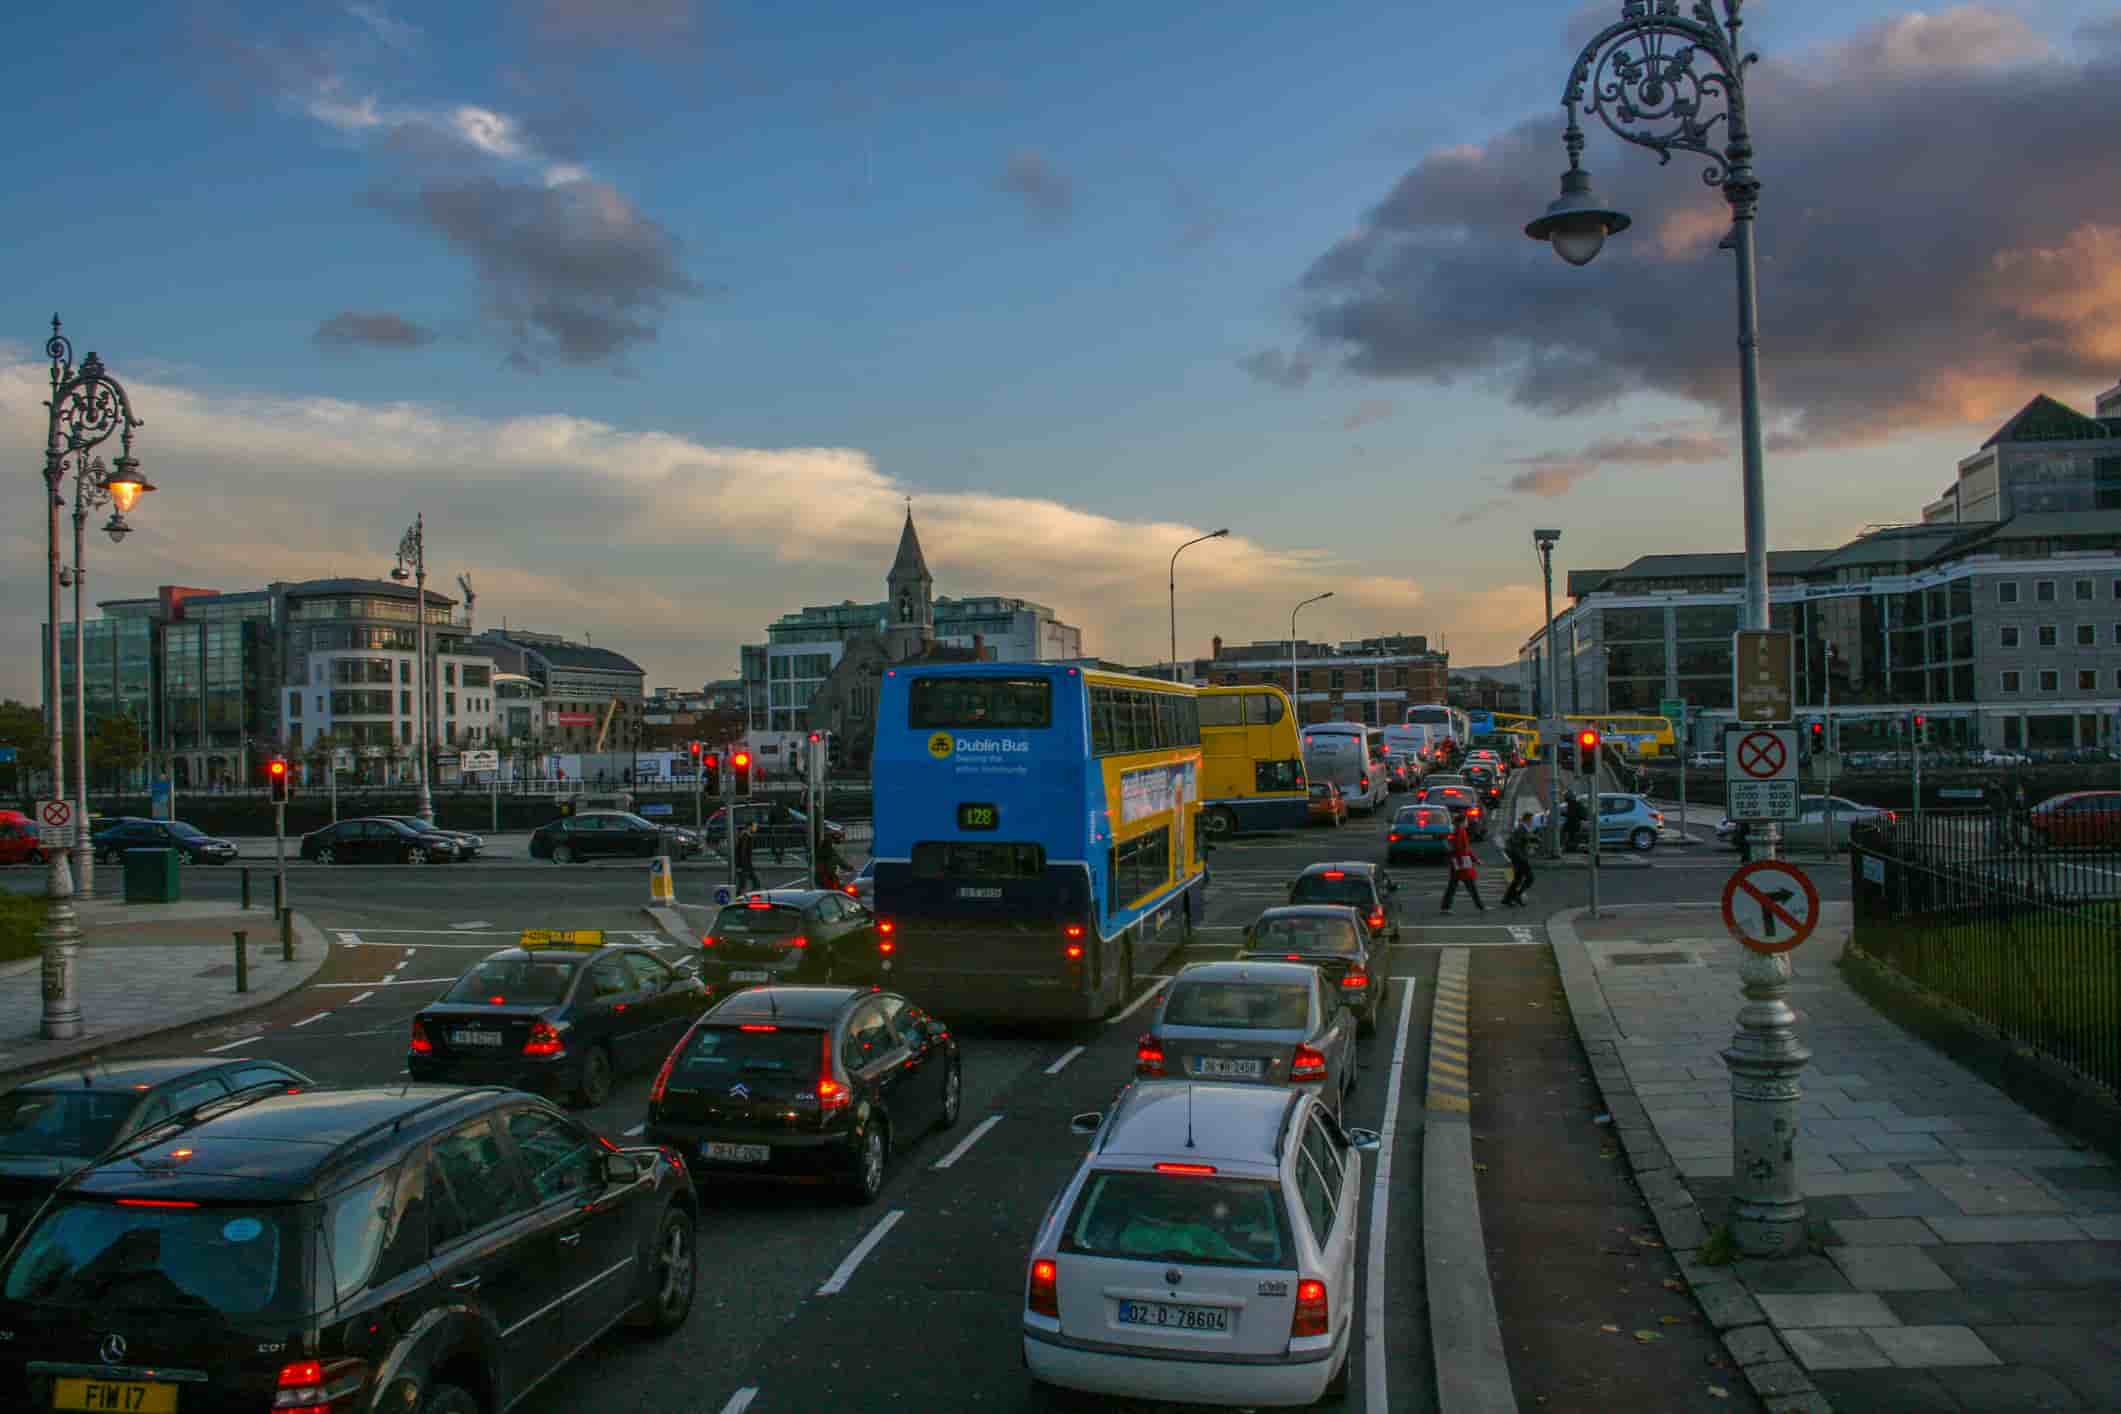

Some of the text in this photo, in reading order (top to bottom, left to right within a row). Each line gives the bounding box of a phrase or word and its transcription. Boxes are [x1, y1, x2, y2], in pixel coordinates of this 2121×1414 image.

[956, 738, 1029, 753] Dublin Bus
[967, 807, 993, 825] 128
[126, 1386, 146, 1410] 17
